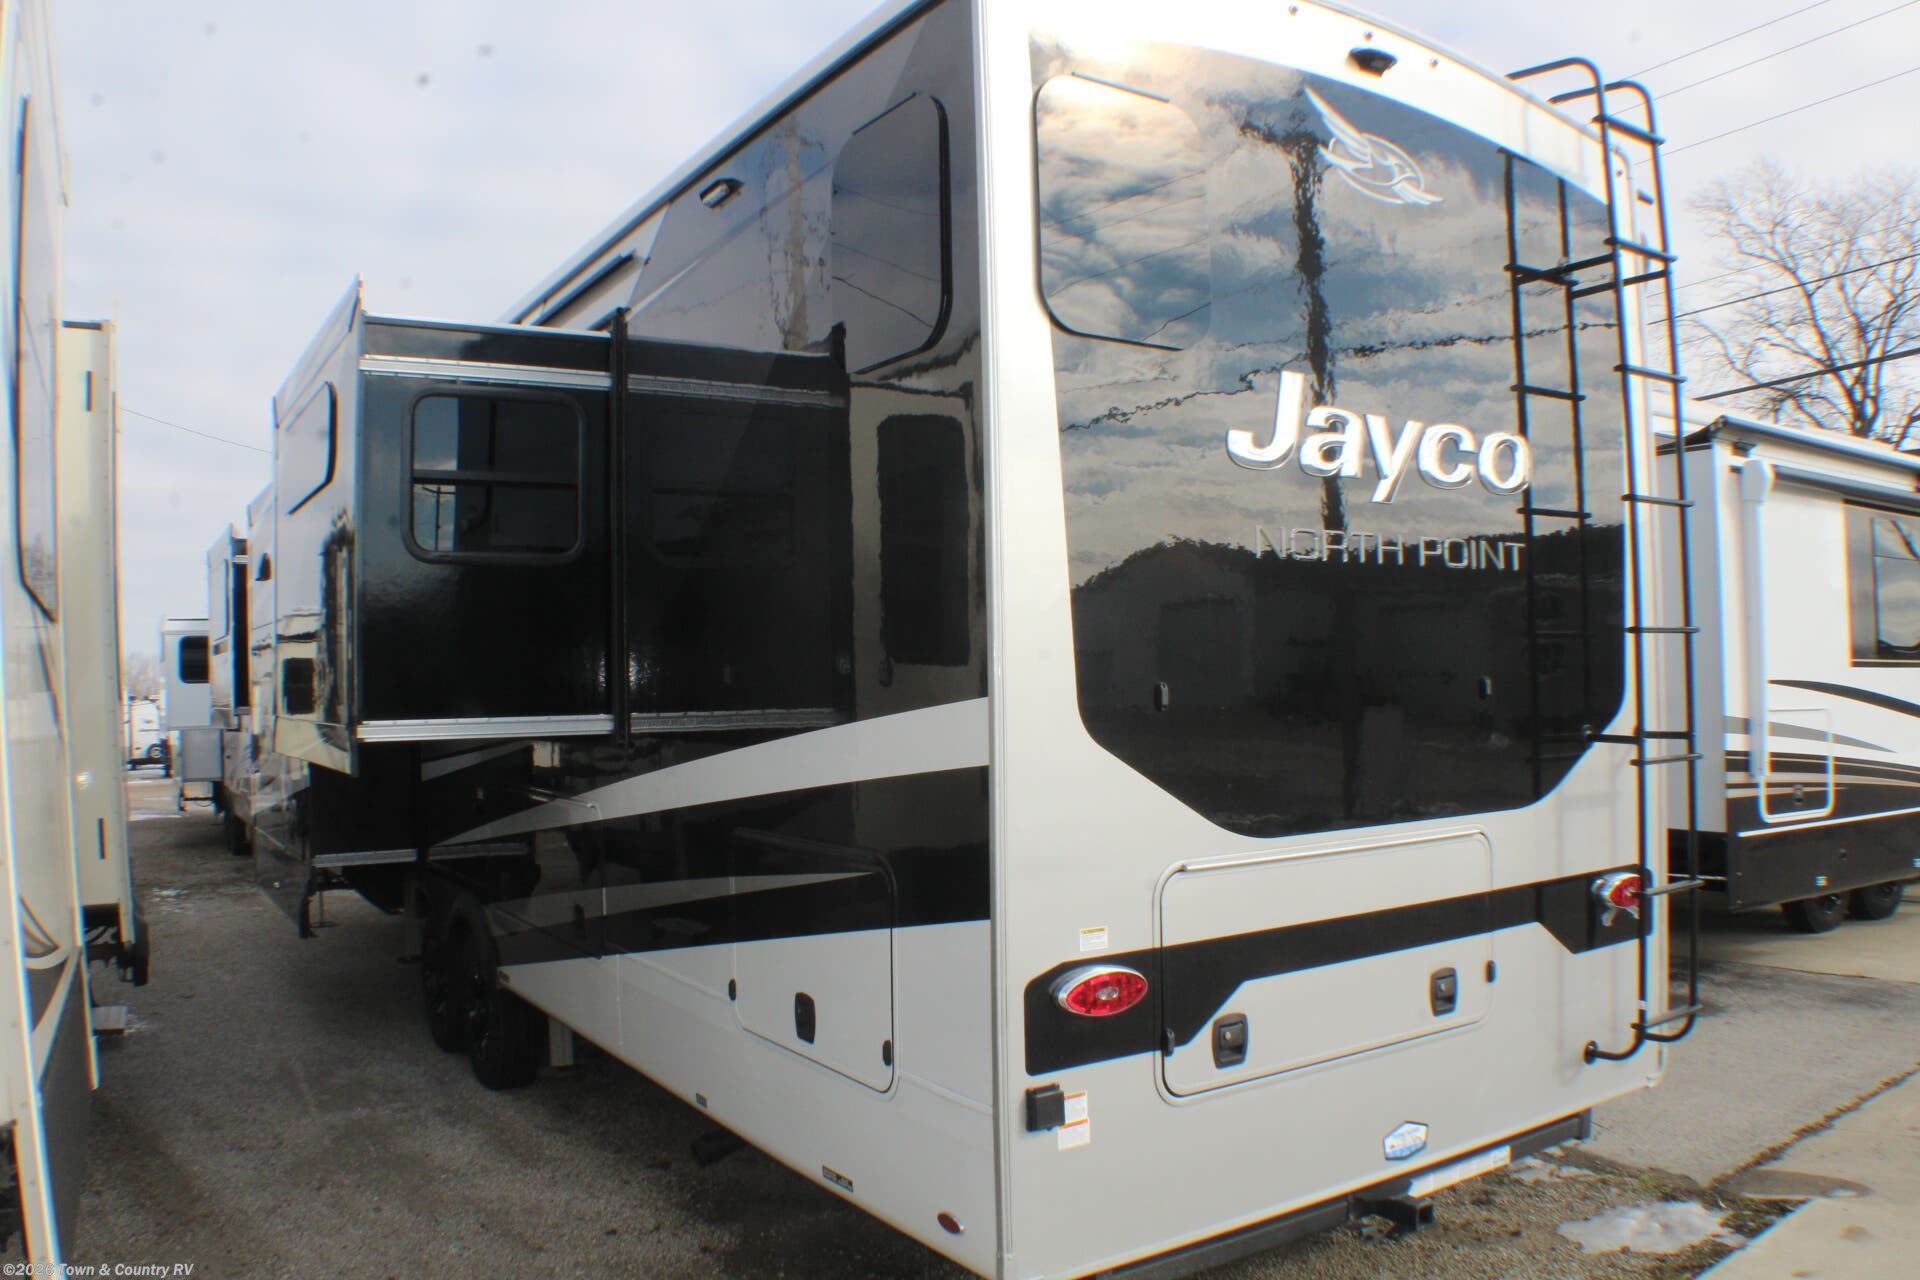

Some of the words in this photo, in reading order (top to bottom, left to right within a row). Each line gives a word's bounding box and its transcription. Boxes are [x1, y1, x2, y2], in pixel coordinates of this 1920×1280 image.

[1226, 370, 1532, 504] Jayco
[1255, 525, 1404, 566] NORTH
[1419, 536, 1526, 571] POINT
